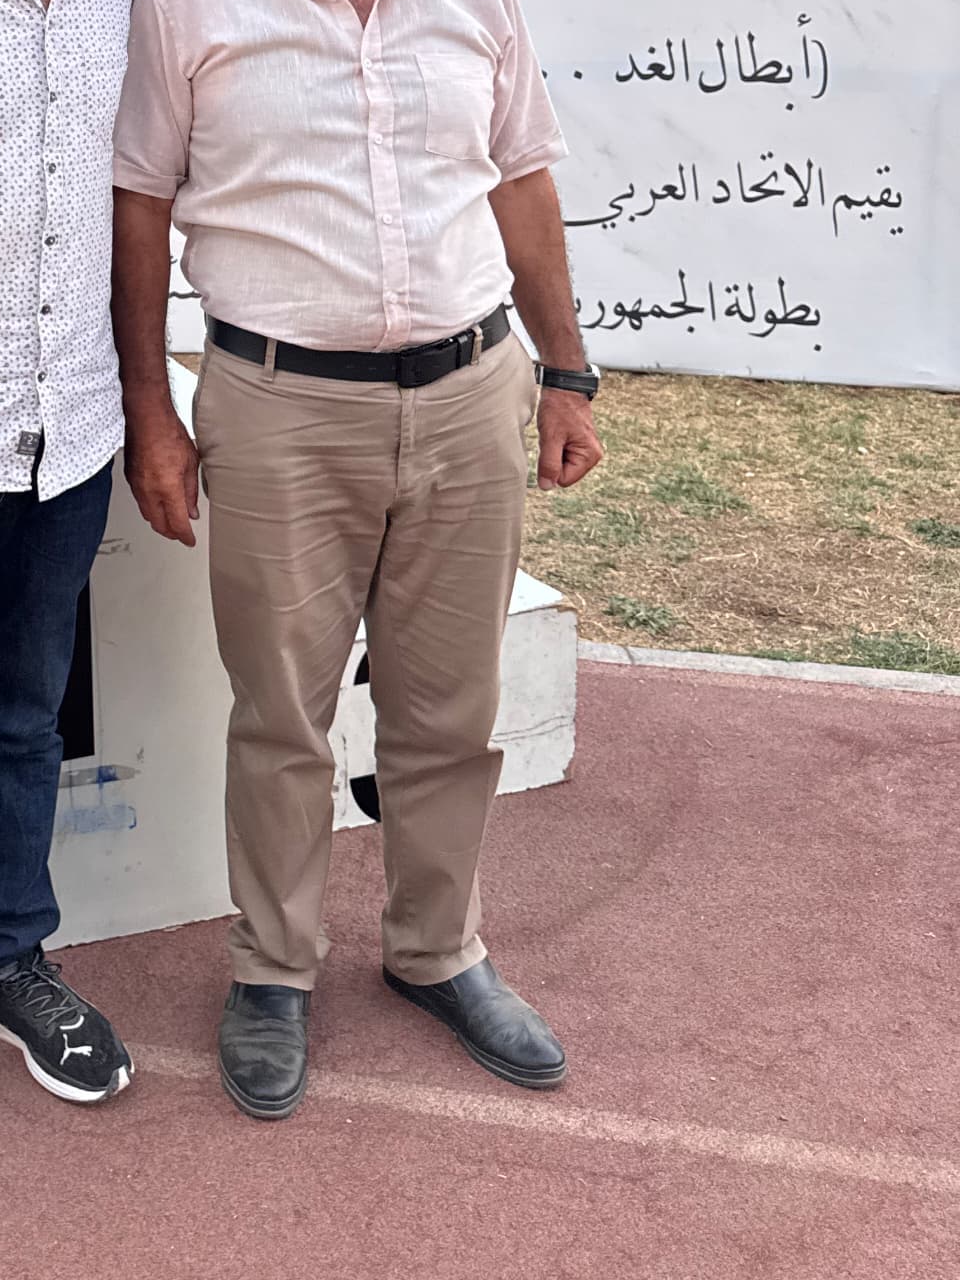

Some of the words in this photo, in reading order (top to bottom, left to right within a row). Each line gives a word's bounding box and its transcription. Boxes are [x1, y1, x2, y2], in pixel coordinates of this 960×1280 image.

[565, 163, 700, 229] العربي
[712, 151, 826, 207] الاتحاد
[724, 276, 823, 352] بطولة
